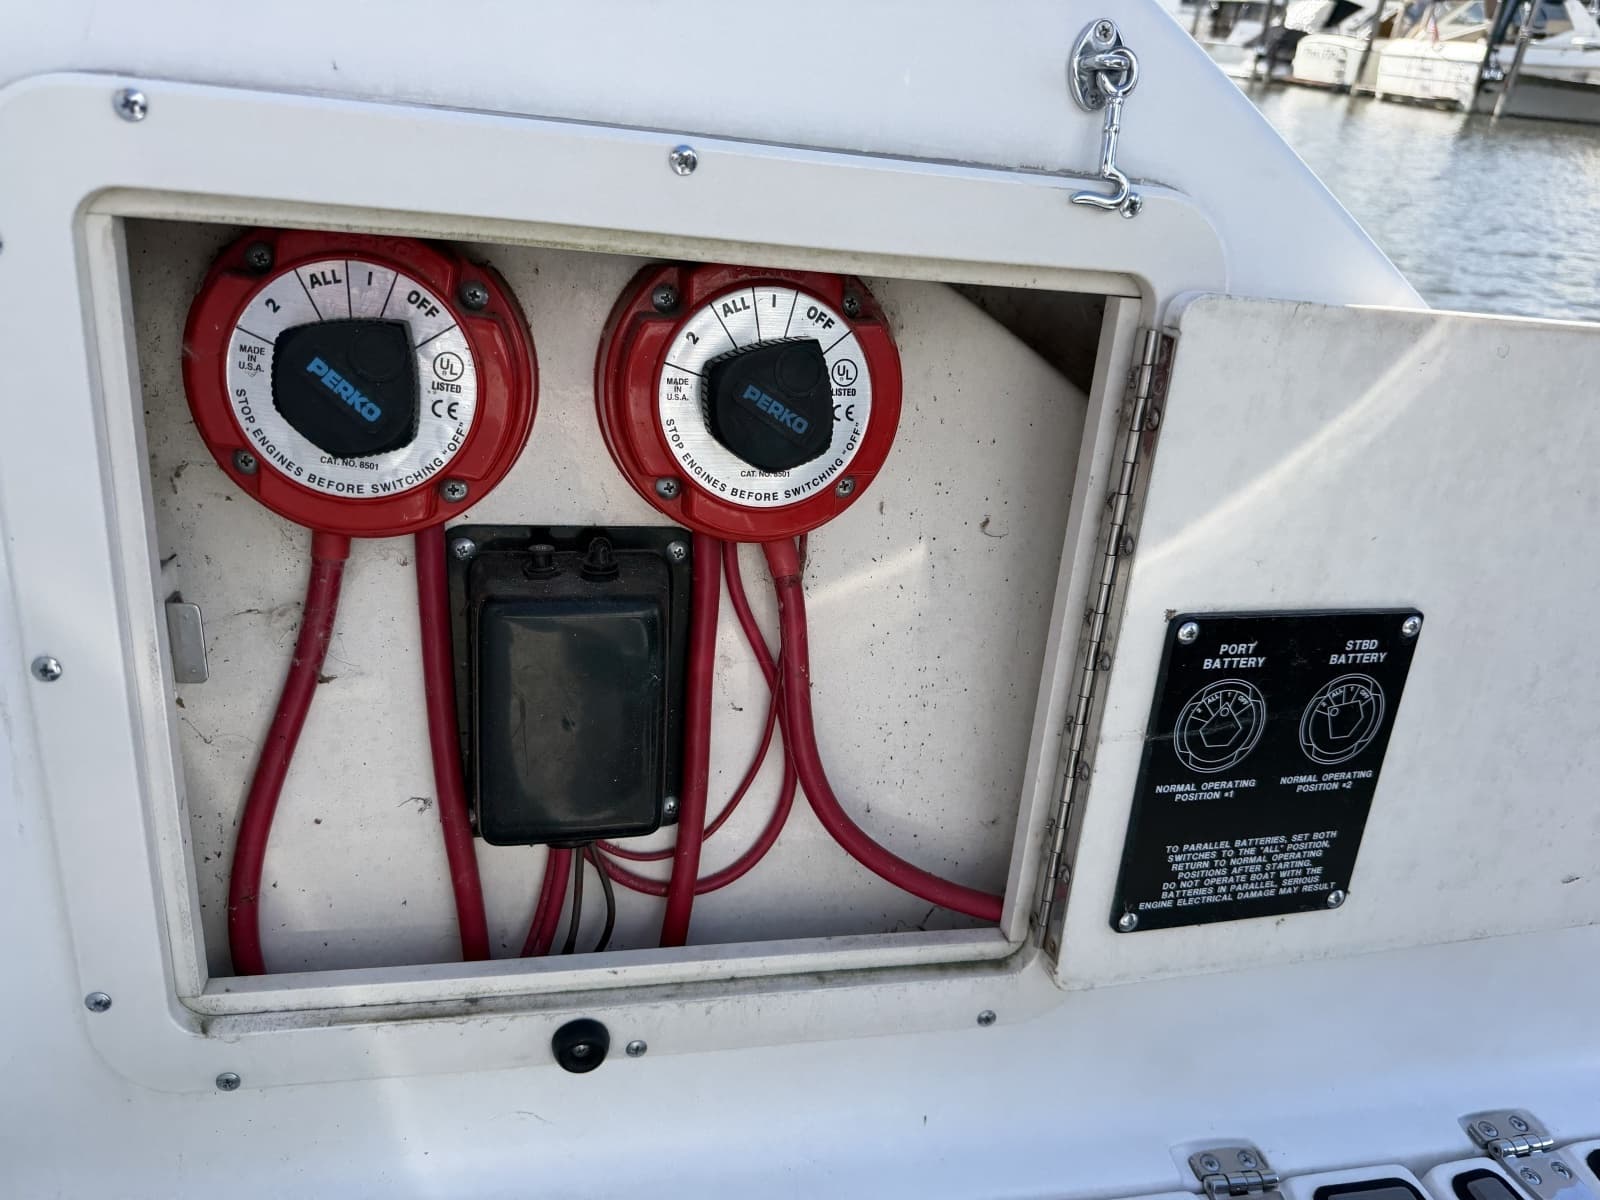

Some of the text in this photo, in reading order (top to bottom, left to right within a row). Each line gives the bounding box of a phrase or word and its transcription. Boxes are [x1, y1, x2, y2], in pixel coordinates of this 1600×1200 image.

[309, 270, 342, 289] ALL
[265, 298, 281, 313] 2
[407, 290, 440, 319] OFF
[722, 297, 750, 317] ALL
[806, 305, 835, 331] OFF
[686, 331, 699, 344] 2
[239, 345, 265, 355] MADE
[248, 354, 257, 362] IN
[238, 363, 264, 372] U.S.A.
[306, 357, 382, 422] PERKO
[432, 381, 461, 394] LISTED
[666, 393, 689, 401] U.S.A.
[432, 400, 459, 420] CE
[741, 385, 809, 434] PERKO
[236, 389, 255, 424] STOP
[252, 428, 303, 477] ENGINES
[307, 474, 364, 494] BEFORE
[371, 457, 444, 494] SWITCHING
[359, 461, 379, 471] 8501
[666, 418, 684, 450] STOP
[682, 454, 727, 491] ENGINES
[731, 488, 779, 501] BEFORE
[784, 458, 844, 499] SWITCHING
[1219, 643, 1256, 655] PORT
[1345, 640, 1378, 651] STBD
[1203, 657, 1266, 669] BATTERY
[1329, 652, 1387, 665] BATTERY
[1207, 694, 1220, 704] ALL
[1331, 689, 1344, 698] ALL
[1280, 770, 1373, 784] NORMAL OPERATING
[1156, 779, 1256, 793] NORMAL OPERATING
[1296, 783, 1338, 792] POSITION
[1174, 792, 1220, 801] POSITION
[1166, 845, 1179, 853] TO
[1183, 841, 1230, 852] PARALLEL
[1291, 834, 1310, 842] SET
[1312, 830, 1338, 839] BOTH
[1167, 852, 1216, 863] SWITCHES
[1171, 861, 1209, 871] RETURN
[1230, 855, 1268, 866] NORMAL
[1271, 850, 1323, 861] OPERATING
[1162, 867, 1323, 890] DO NOT OPERATE BOAT WITH THE
[1178, 868, 1227, 879] POSITIONS
[1231, 865, 1261, 874] AFTER
[1161, 888, 1213, 899] BATTERIES
[1217, 885, 1227, 893] IN
[1282, 876, 1320, 886] SERIOUS
[1138, 882, 1336, 910] ENGINE ELECTRICAL DAMAGE MAY RESULT
